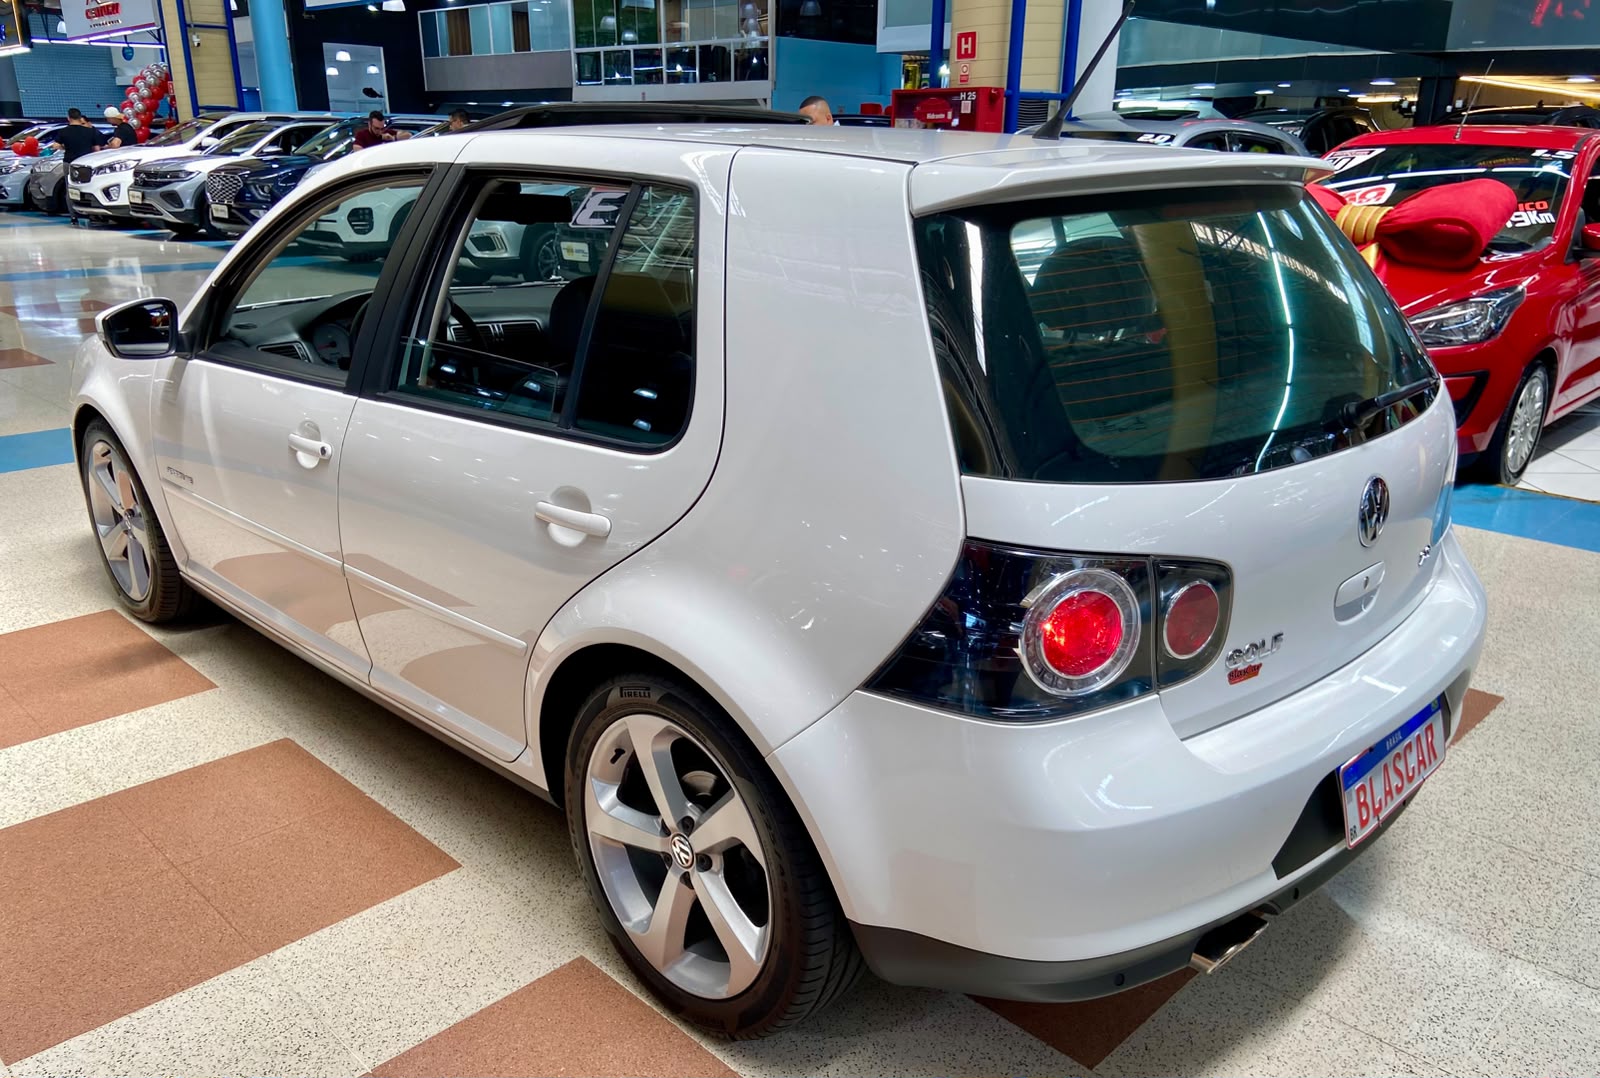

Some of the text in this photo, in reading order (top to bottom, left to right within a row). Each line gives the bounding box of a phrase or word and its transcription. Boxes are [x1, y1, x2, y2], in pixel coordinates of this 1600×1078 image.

[961, 36, 972, 55] H
[960, 91, 977, 101] H 25
[1136, 133, 1172, 144] 2.0
[1531, 149, 1579, 160] 1.5
[1225, 632, 1284, 669] GOLF
[620, 686, 651, 698] PIRELLI
[1355, 722, 1438, 830] BLASCAR
[1350, 825, 1358, 842] BR
